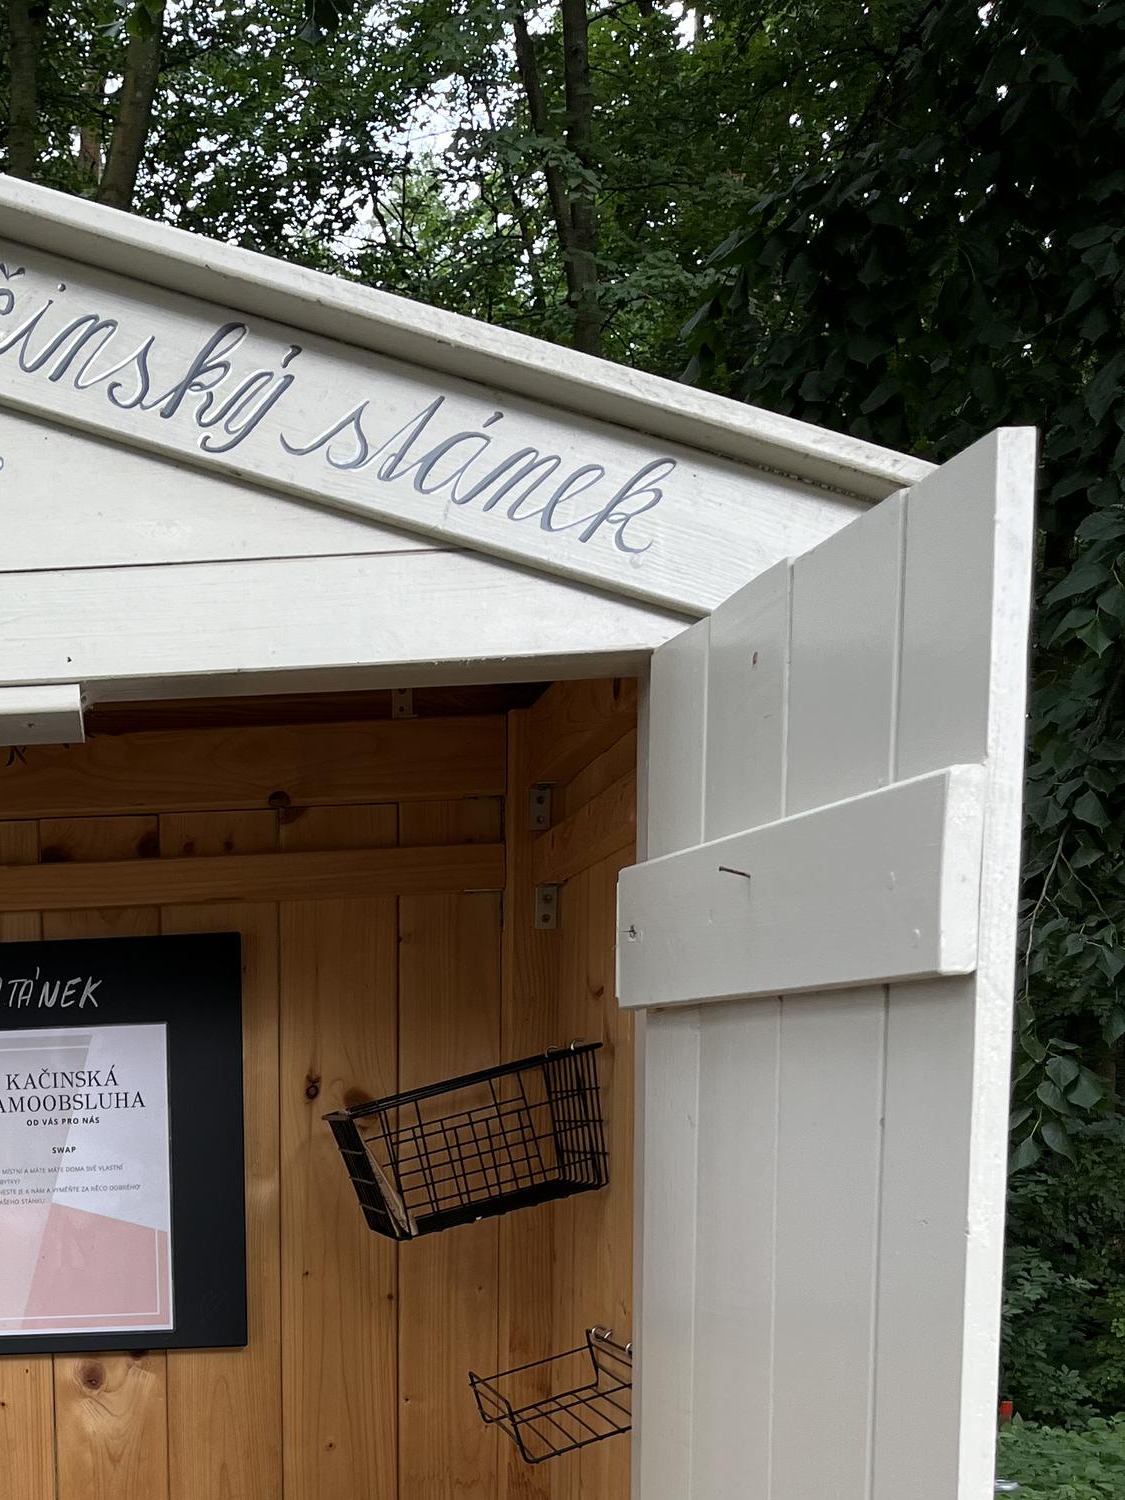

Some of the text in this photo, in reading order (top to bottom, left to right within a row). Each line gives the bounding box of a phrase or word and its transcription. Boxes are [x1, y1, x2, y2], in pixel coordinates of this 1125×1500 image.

[279, 394, 677, 556] stánek
[6, 1064, 119, 1091] KAČINSKÁ
[26, 1115, 100, 1127] OD VÁS PRO NÁS
[52, 1146, 77, 1154] SWAP
[65, 1165, 84, 1173] DOMA
